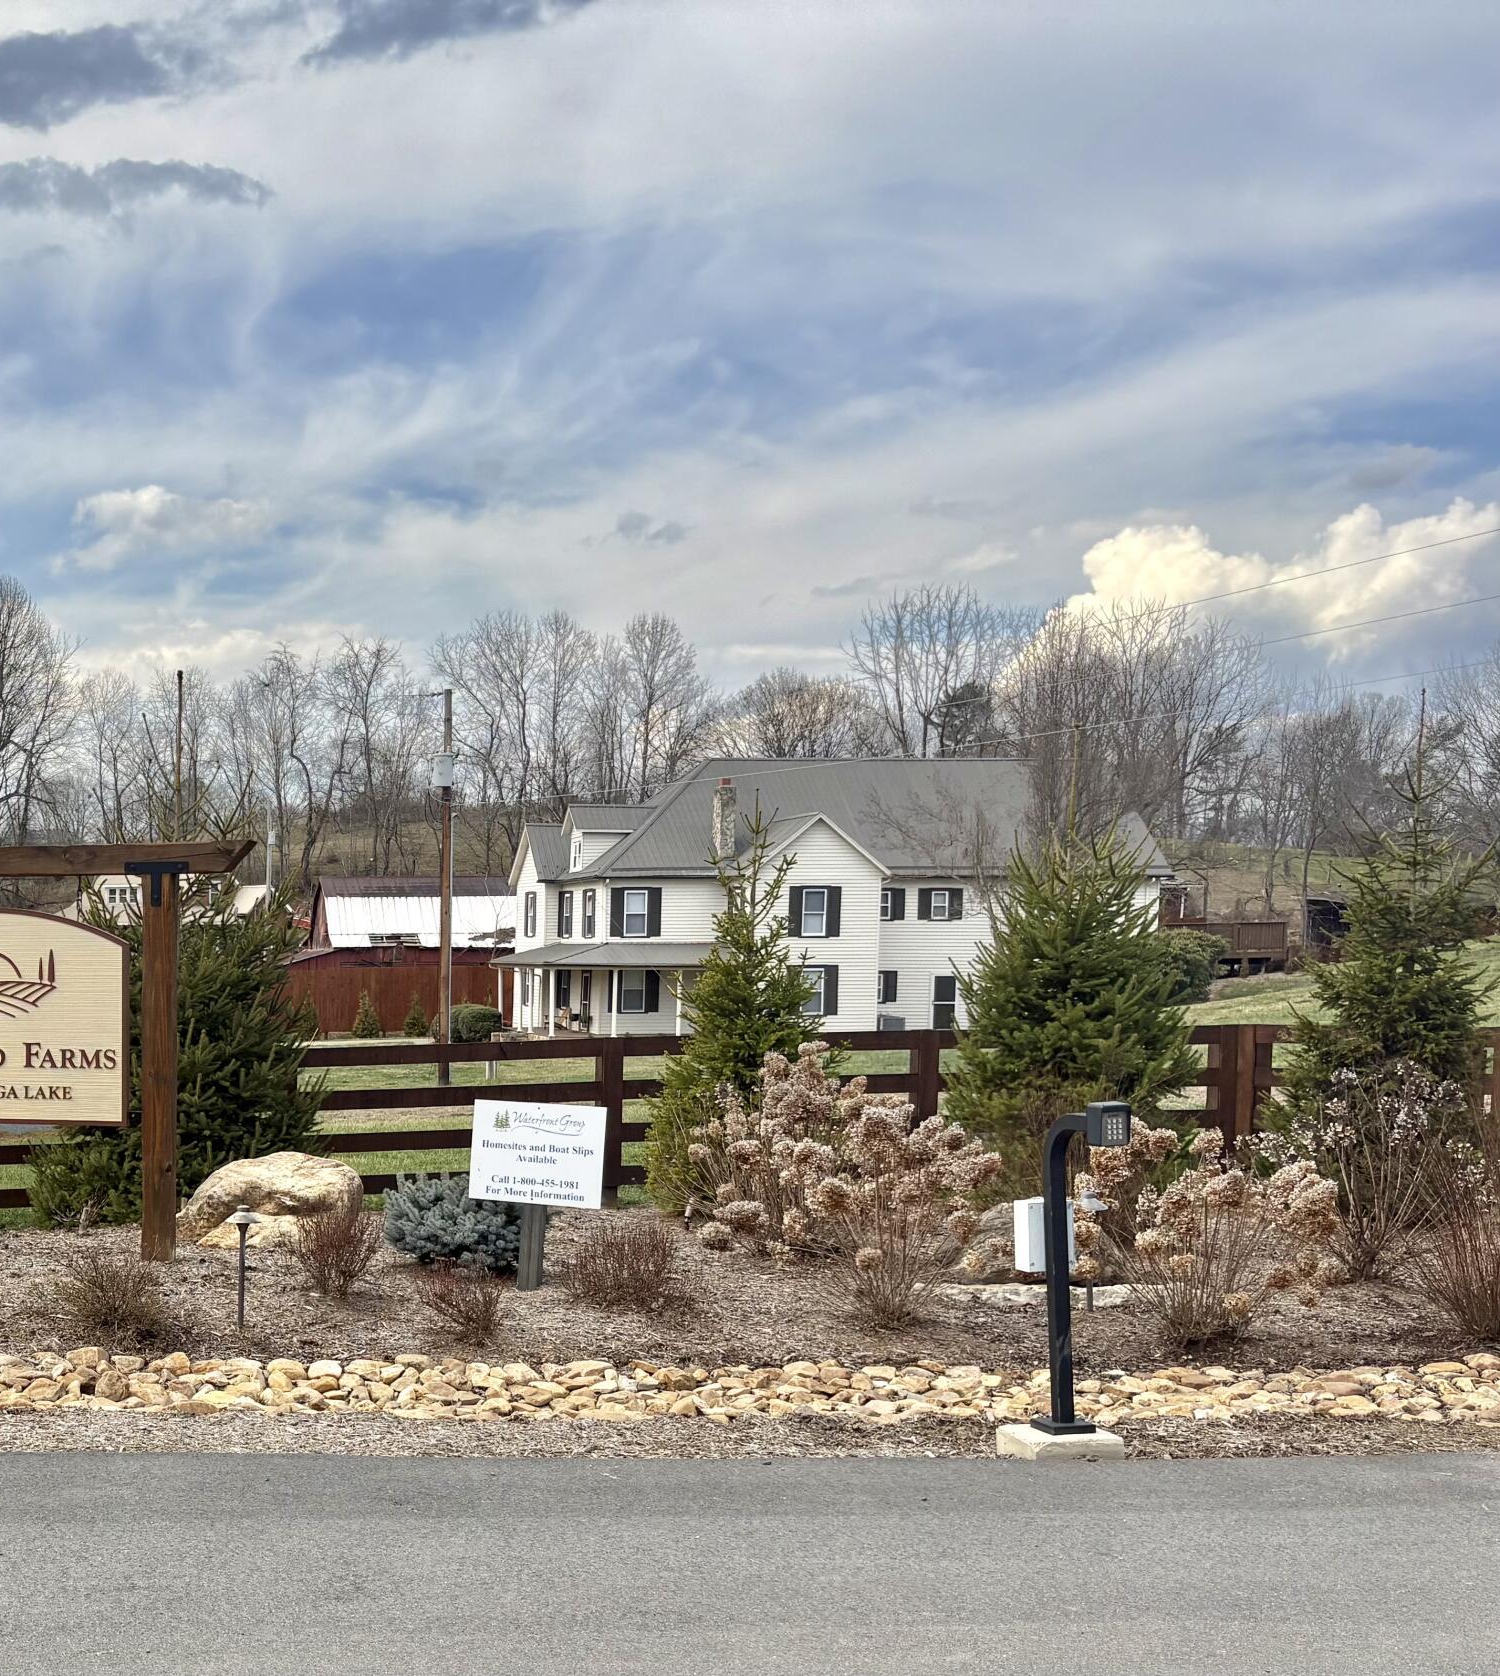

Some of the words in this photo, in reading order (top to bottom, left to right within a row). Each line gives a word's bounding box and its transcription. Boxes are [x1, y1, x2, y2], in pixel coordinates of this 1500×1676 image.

[24, 1086, 72, 1100] LAKE
[512, 1111, 559, 1127] Waterfront
[560, 1114, 586, 1132] Group
[482, 1139, 527, 1151] Homesites
[529, 1142, 546, 1152] and
[549, 1144, 569, 1154] Boat
[572, 1146, 594, 1157] Slips
[516, 1154, 557, 1165] Available
[491, 1175, 509, 1184] Call
[513, 1176, 579, 1190] 1-800-455-1981
[485, 1186, 501, 1194] For
[504, 1187, 528, 1197] More
[530, 1189, 585, 1202] Information
